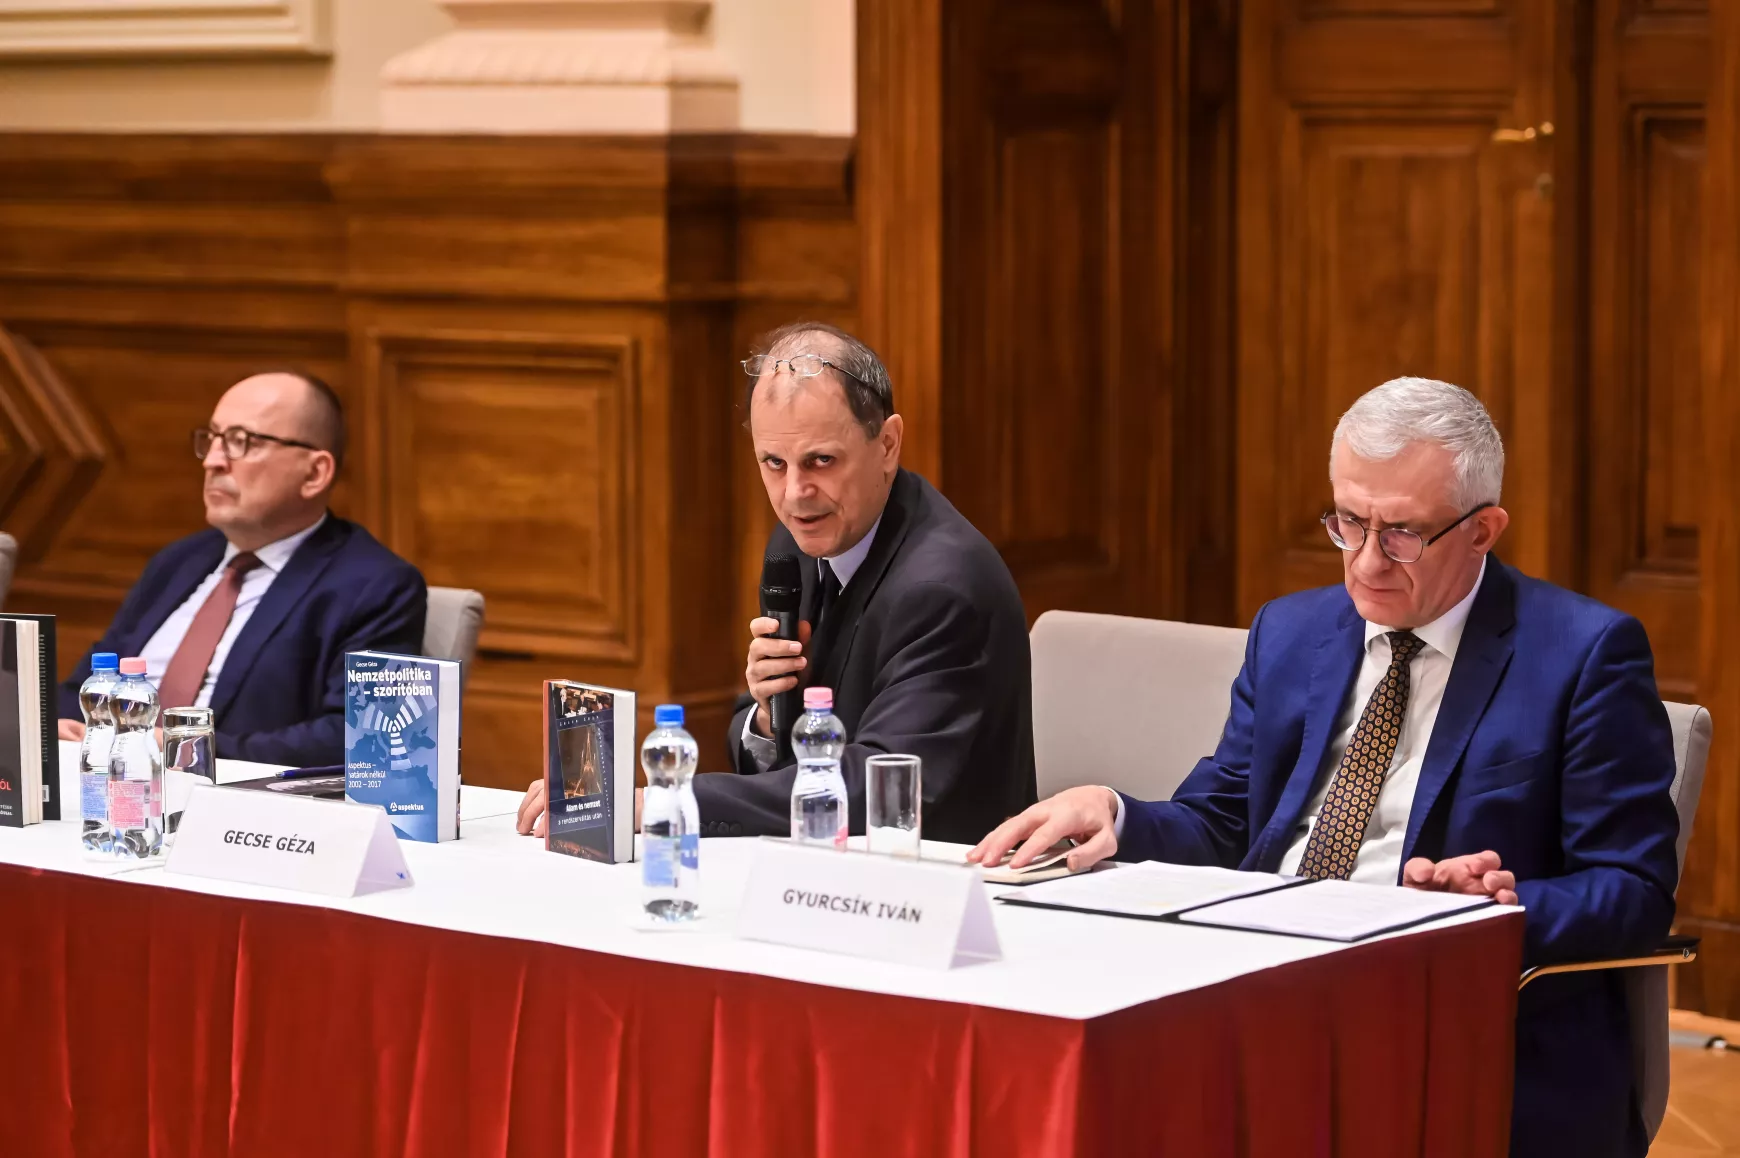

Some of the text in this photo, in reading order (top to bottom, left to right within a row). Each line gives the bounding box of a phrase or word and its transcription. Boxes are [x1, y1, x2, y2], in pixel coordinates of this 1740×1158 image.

[348, 668, 432, 684] Nemzetpolitika
[373, 683, 433, 697] szorítóban
[348, 780, 362, 788] 2002
[367, 780, 382, 788] 2017
[398, 803, 424, 812] aspektus
[223, 829, 315, 855] GECSE GÉZA
[783, 888, 922, 924] GYURCSÍK IVÁN
